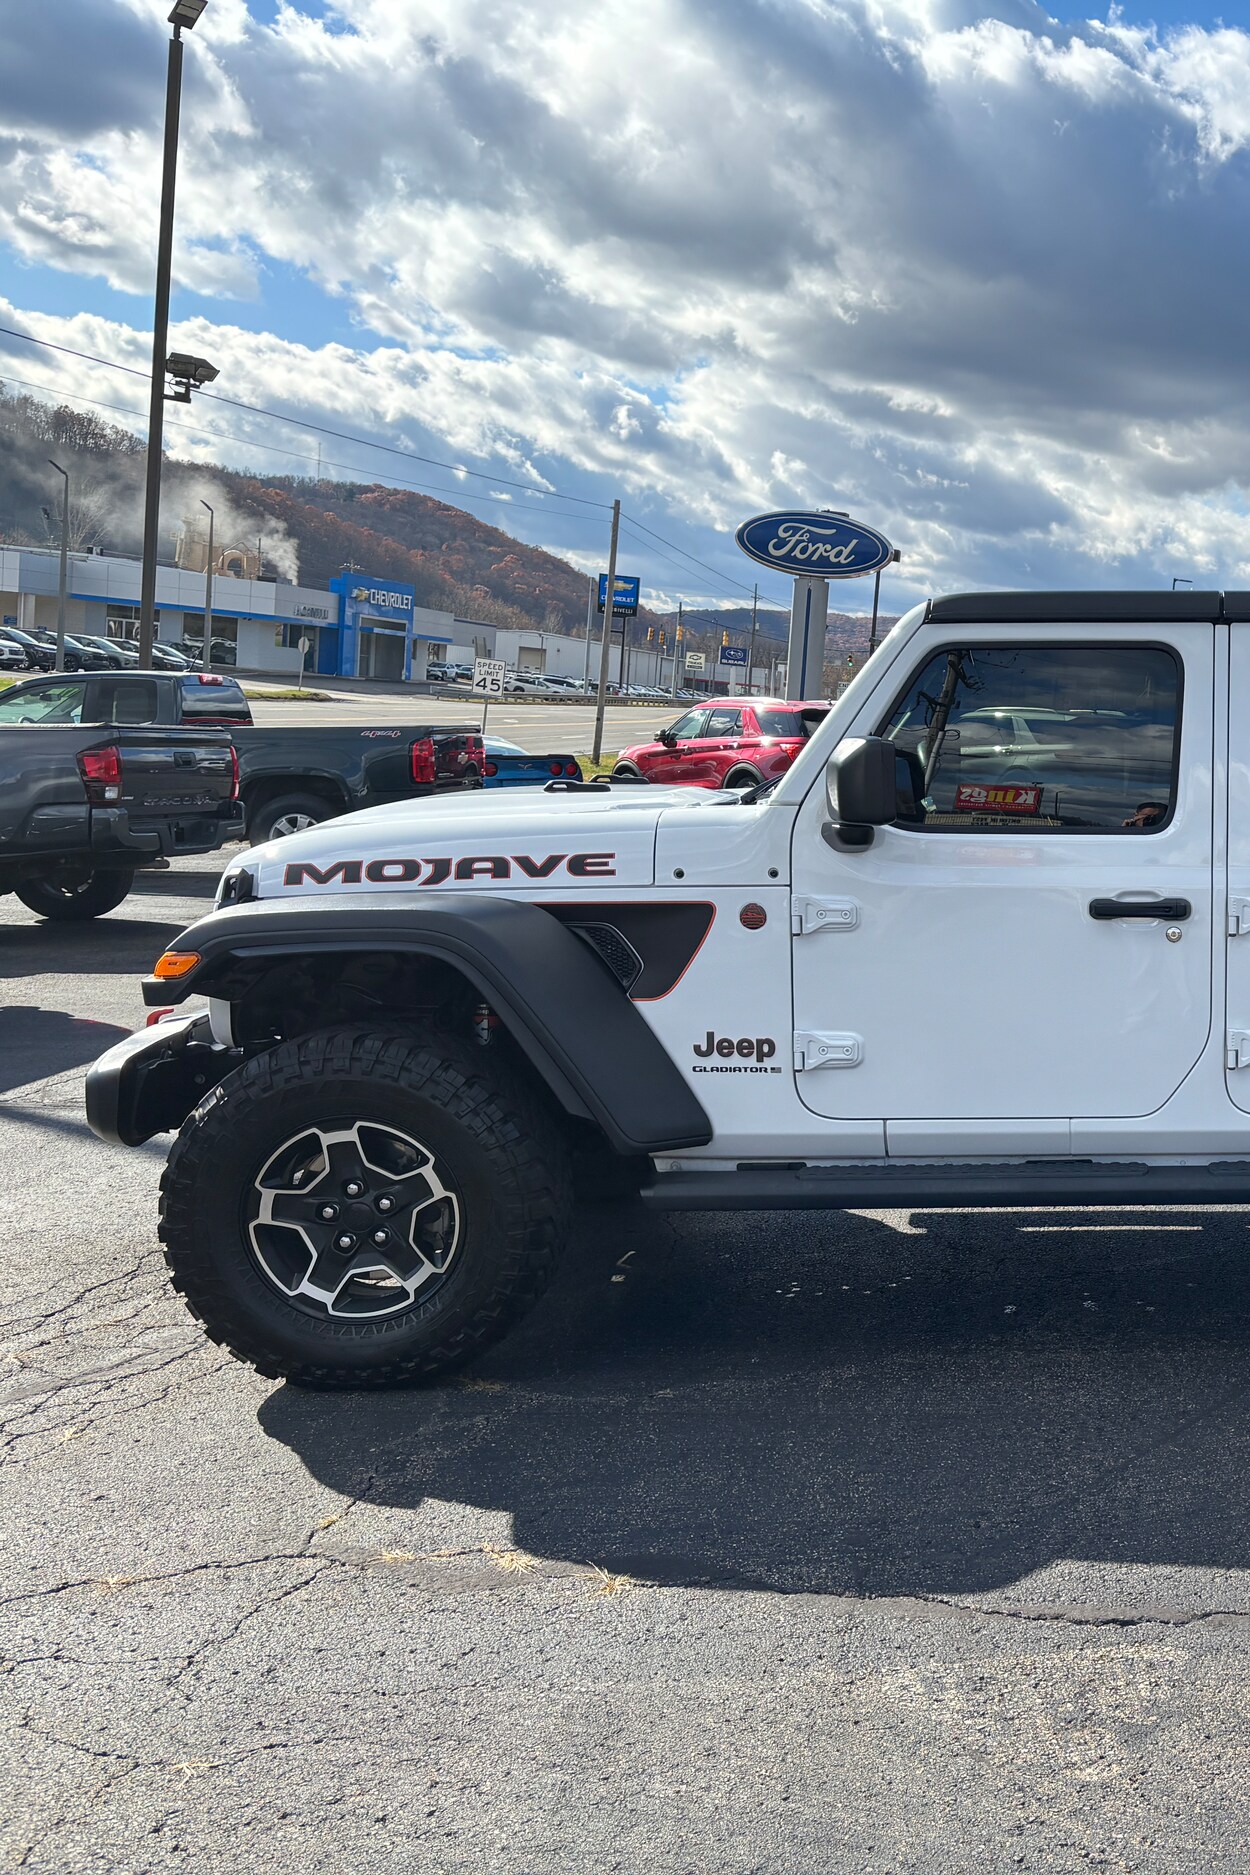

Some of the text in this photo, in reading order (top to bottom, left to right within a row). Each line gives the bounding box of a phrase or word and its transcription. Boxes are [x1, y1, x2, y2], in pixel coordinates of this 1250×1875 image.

[768, 522, 859, 564] Ford
[370, 588, 412, 609] CHEVROLET
[477, 662, 503, 670] SPEED
[475, 677, 501, 692] 45
[283, 853, 616, 886] MOJAVE
[693, 1031, 776, 1063] Jeep
[692, 1065, 768, 1073] GLADIATOR
